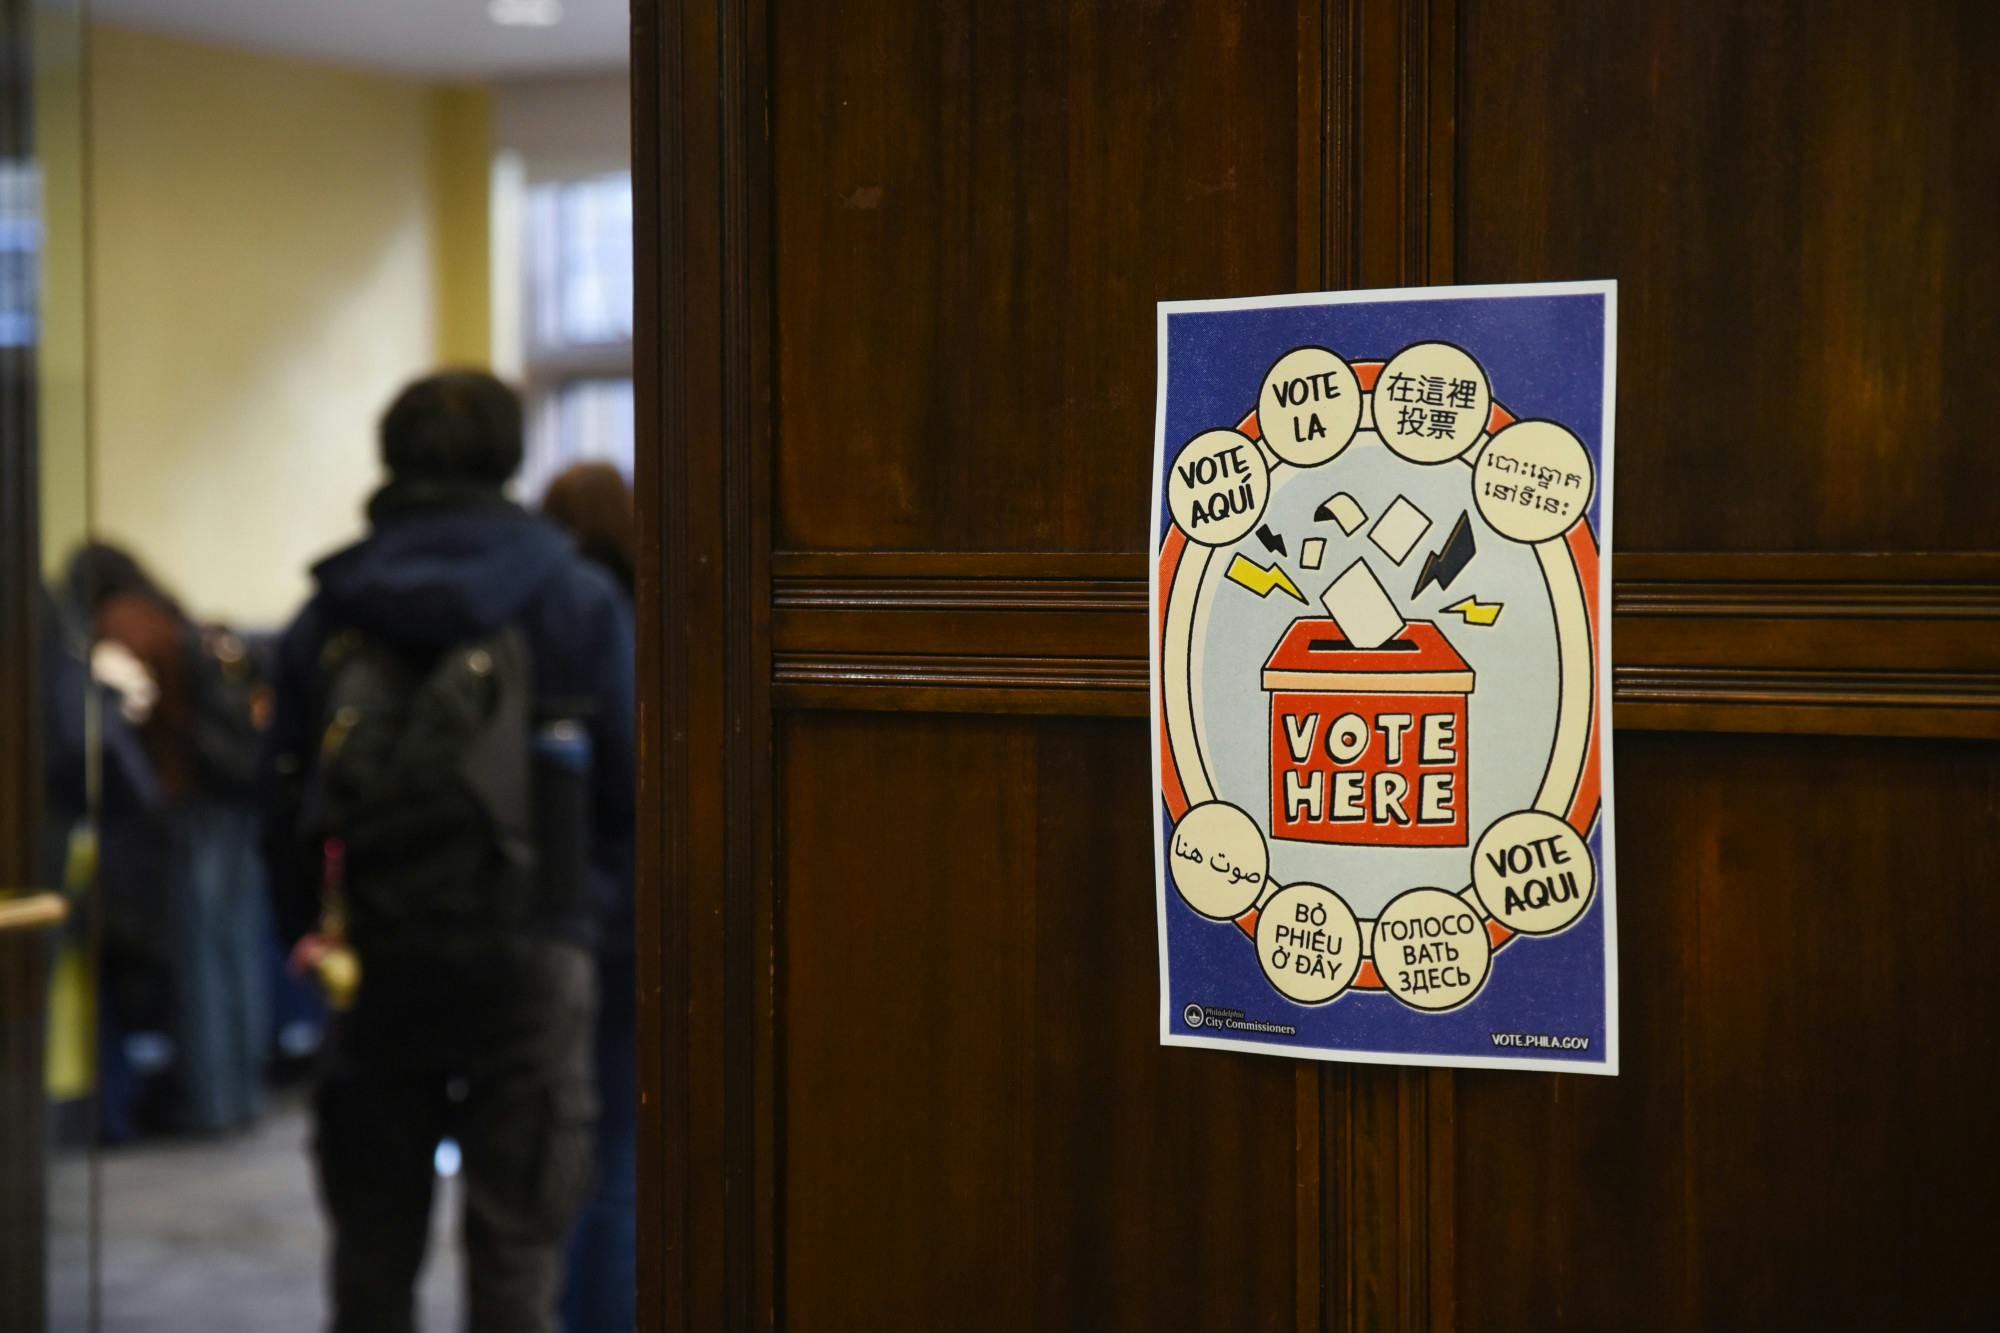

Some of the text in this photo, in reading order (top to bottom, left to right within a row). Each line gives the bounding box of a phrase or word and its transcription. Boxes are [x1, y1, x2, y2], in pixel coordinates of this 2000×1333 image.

[1272, 371, 1341, 408] VOTE
[1386, 372, 1477, 410] 在這裡
[1293, 413, 1327, 442] LA
[1396, 405, 1458, 440] 投票
[1178, 445, 1250, 489] VOTE
[1191, 473, 1255, 528] AQUÍ
[1282, 713, 1457, 766] VOTE
[1283, 769, 1456, 827] HERE
[1175, 834, 1261, 885] صوت هنا
[1485, 834, 1572, 878] VOTE
[1505, 871, 1579, 916] AQUI
[1295, 902, 1327, 927] BỎ
[1381, 913, 1475, 942] ГОЛОСО
[1271, 945, 1343, 981] Ở ĐÂY
[1403, 942, 1460, 966] ВАТЬ
[1398, 966, 1471, 995] ЗДЕСЬ
[1205, 1017, 1296, 1035] City Commissioners
[1491, 1033, 1589, 1050] VOTE.PHILA.GOV
